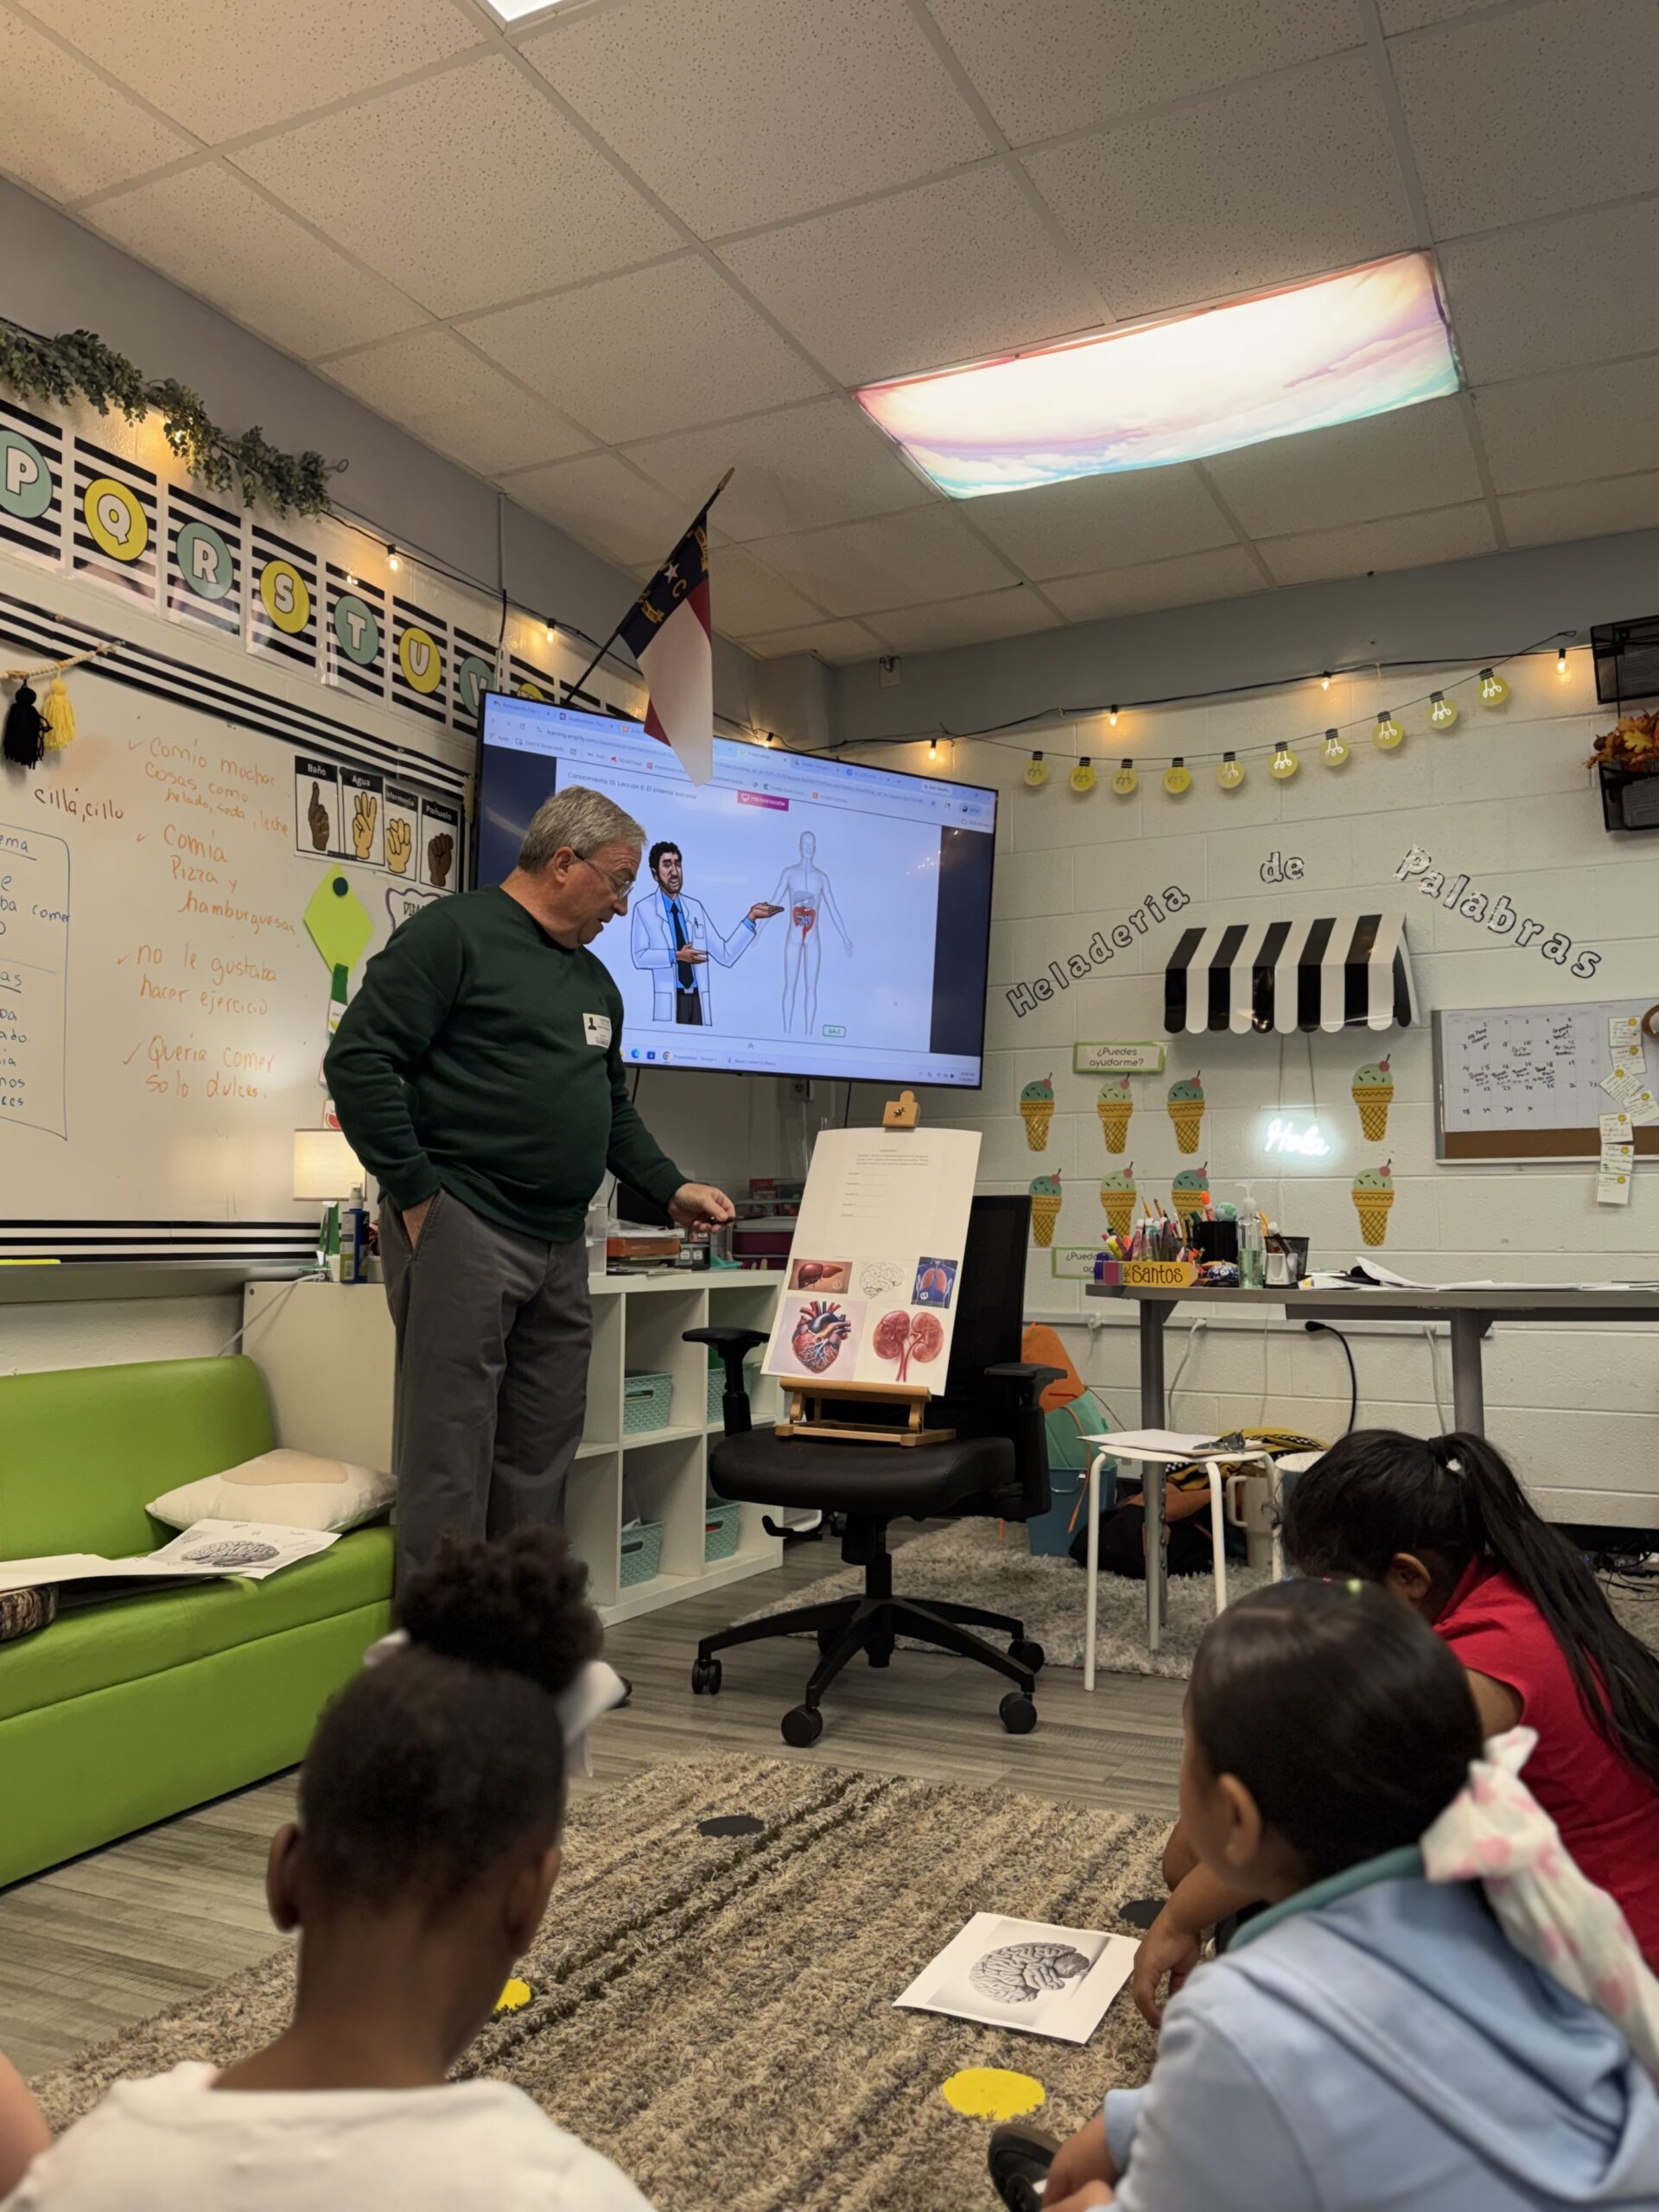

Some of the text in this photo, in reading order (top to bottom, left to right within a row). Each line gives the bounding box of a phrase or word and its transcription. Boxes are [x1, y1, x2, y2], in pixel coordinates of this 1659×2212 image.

[6, 446, 39, 496] P
[97, 493, 131, 545] Q
[193, 537, 219, 584] R
[274, 572, 295, 614] S
[347, 611, 366, 651] T
[409, 639, 430, 677] U
[308, 764, 327, 777] Baño
[353, 774, 371, 787] Agua
[426, 804, 453, 821] Pañuelo
[228, 878, 238, 893] y
[178, 890, 296, 935] hamburguesas
[1006, 844, 1601, 1018] Heladería de Palabras
[183, 942, 197, 969] le
[211, 955, 276, 986] gustaba
[140, 973, 268, 1015] hacer ejercicio
[1096, 1047, 1137, 1057] ¿Puedes
[1090, 1057, 1144, 1068] ayudarme?
[1264, 1117, 1331, 1157] Hola
[1132, 1265, 1183, 1284] Santos
